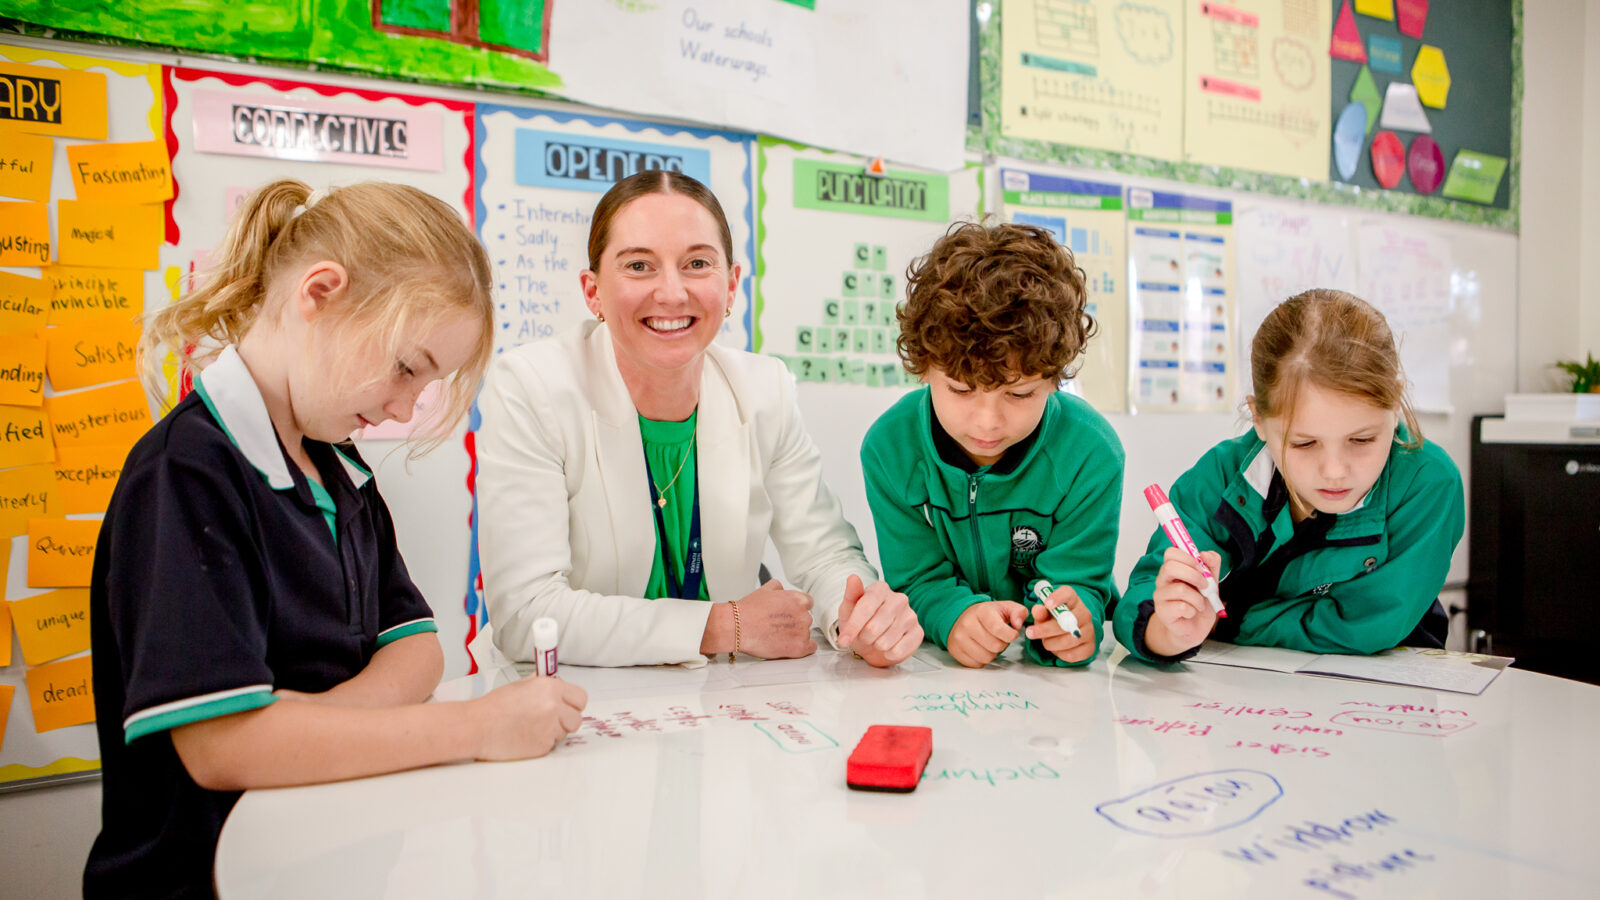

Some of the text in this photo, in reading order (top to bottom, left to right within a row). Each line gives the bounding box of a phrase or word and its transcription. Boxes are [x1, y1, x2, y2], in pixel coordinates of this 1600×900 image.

[681, 7, 773, 48] Our schools
[77, 161, 166, 190] Fascinating
[817, 170, 927, 211] PUNCTUATION
[0, 235, 50, 263] usting
[516, 253, 569, 273] As the
[513, 274, 548, 296] The
[519, 298, 560, 315] Next
[517, 319, 553, 339] Also
[0, 362, 43, 393] nding
[0, 419, 44, 442] fied
[55, 407, 145, 438] mysterious
[36, 610, 85, 631] unique
[43, 679, 88, 703] dead
[921, 761, 1060, 787] pictur
